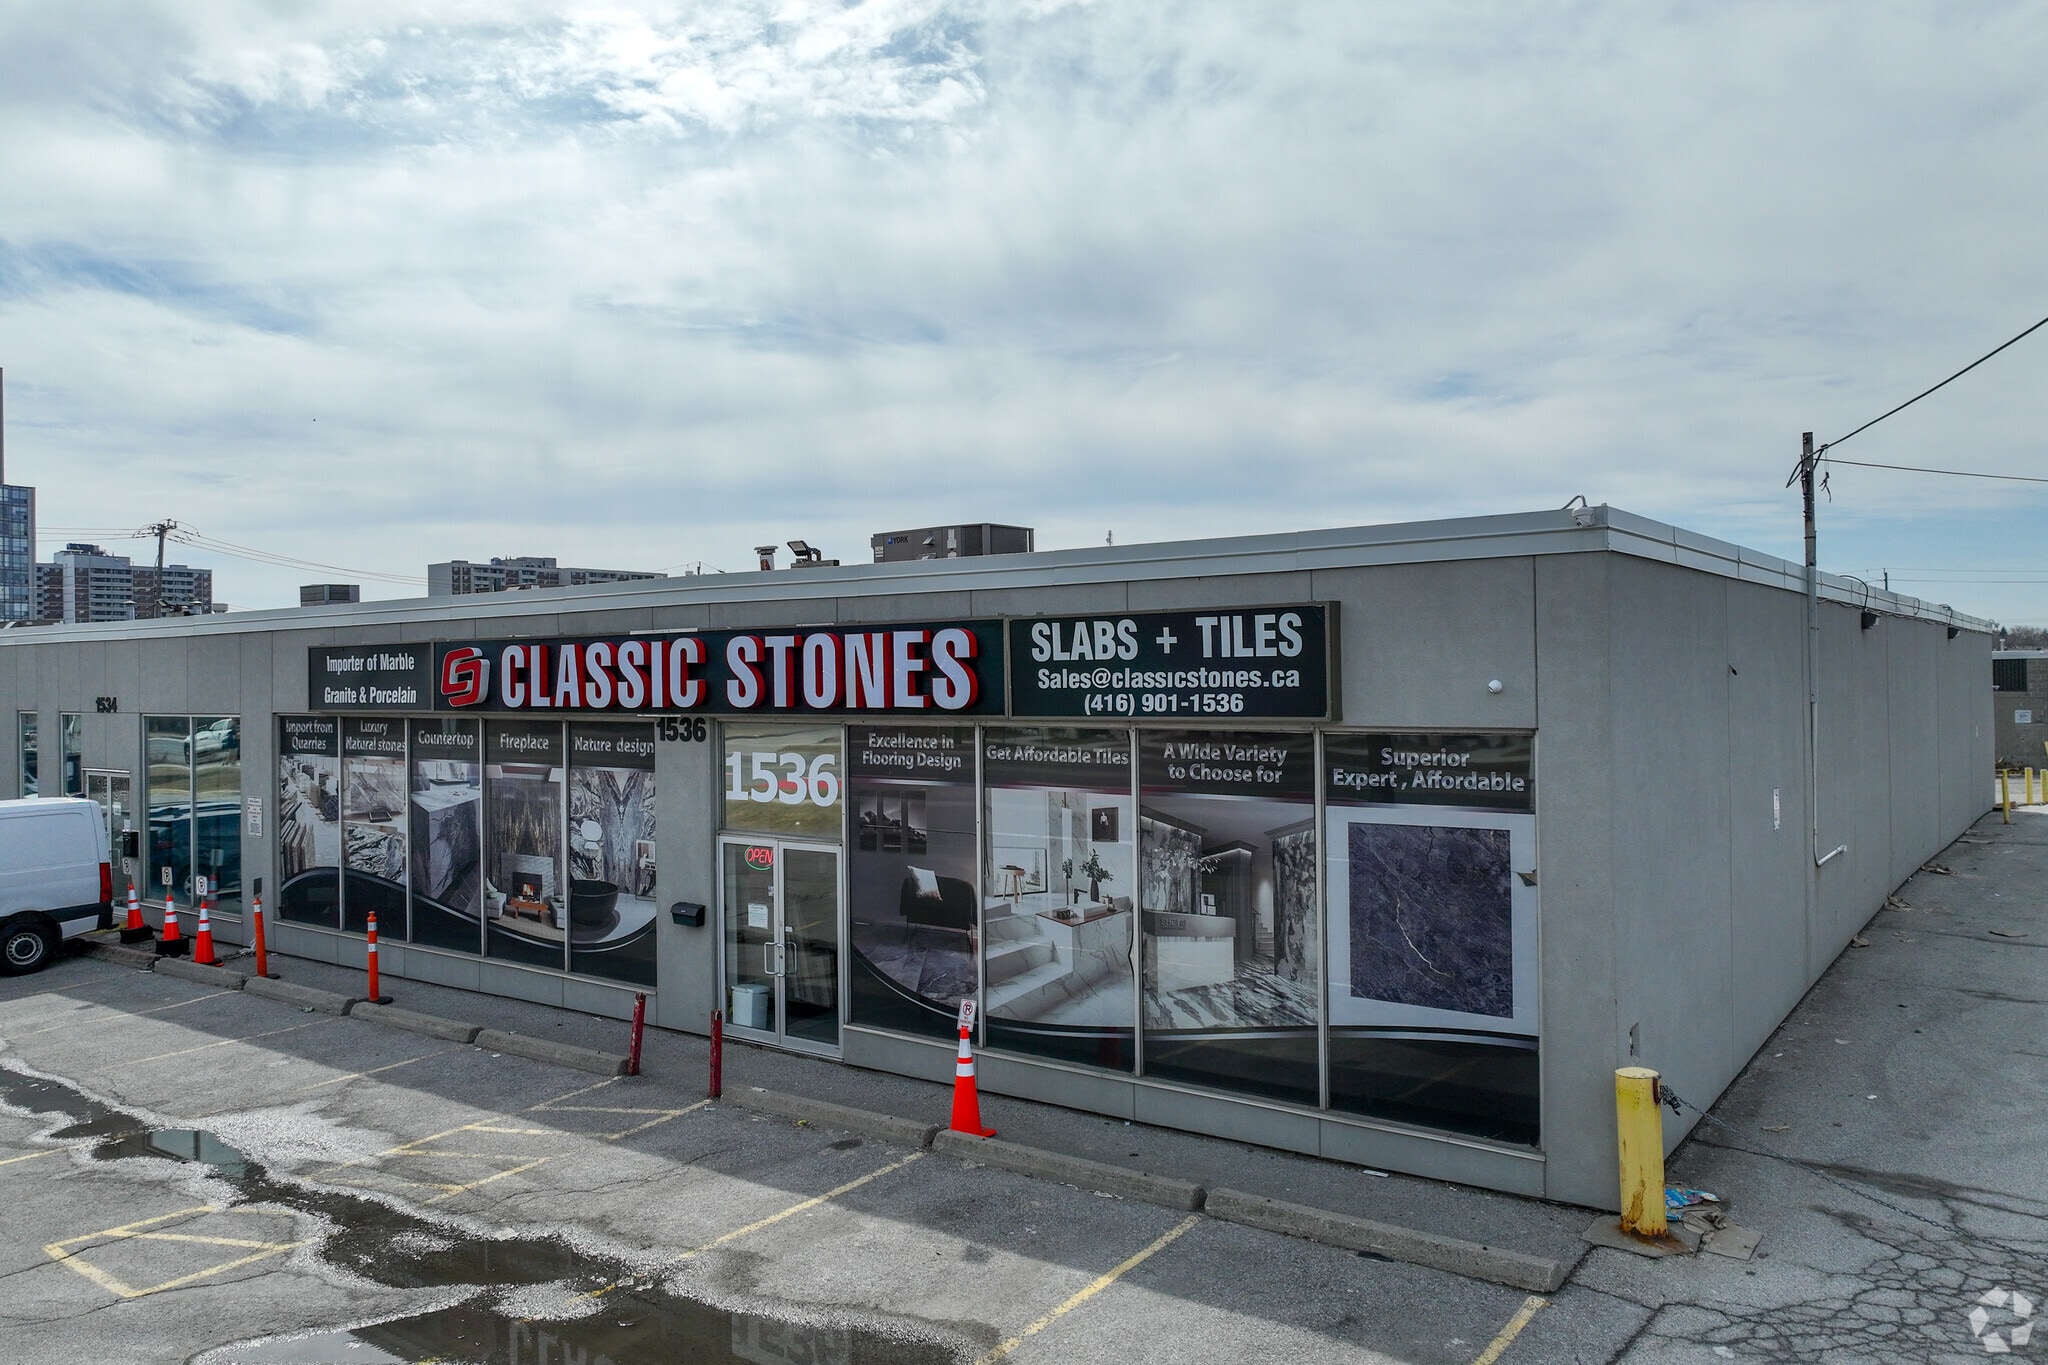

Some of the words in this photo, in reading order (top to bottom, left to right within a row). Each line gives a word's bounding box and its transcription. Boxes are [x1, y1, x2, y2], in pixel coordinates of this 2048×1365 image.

[893, 536, 909, 544] YORK
[1031, 619, 1138, 662] SLABS
[1196, 613, 1303, 658] TILES
[326, 654, 364, 675] Importer
[366, 653, 377, 671] of
[380, 652, 415, 671] Marble
[501, 637, 706, 709] CLASSIC
[726, 628, 979, 710] STONES
[1037, 667, 1300, 689] Sales@classicstones.ca
[95, 696, 118, 713] 1534
[324, 686, 357, 704] Granite
[359, 686, 367, 704] &
[369, 686, 417, 704] Porcelain
[1083, 693, 1135, 716] (416)
[1141, 692, 1244, 713] 901-1536
[285, 719, 313, 736] Import
[314, 719, 334, 734] from
[360, 720, 388, 737] Luxury
[656, 717, 707, 742] 1536
[291, 736, 327, 751] Quarries
[345, 736, 376, 751] Natural
[377, 739, 406, 753] stones
[418, 730, 474, 749] Countertop
[500, 733, 549, 752] Fireplace
[574, 736, 612, 752] Nature
[616, 737, 654, 757] design
[868, 732, 938, 749] Excellence
[942, 734, 955, 749] in
[862, 750, 914, 769] Flooring
[916, 752, 961, 771] Design
[986, 744, 1012, 760] Get
[1013, 746, 1091, 764] Affordable
[1093, 748, 1129, 765] Tiles
[1163, 743, 1176, 759] A
[1178, 743, 1221, 760] Wide
[1223, 744, 1288, 767] Variety
[1380, 747, 1470, 770] Superior
[725, 751, 839, 807] 1536
[1168, 763, 1186, 779] to
[1189, 763, 1253, 782] Choose
[1256, 765, 1283, 783] for
[1411, 770, 1525, 792] Affordable
[746, 848, 773, 863] OPEN
